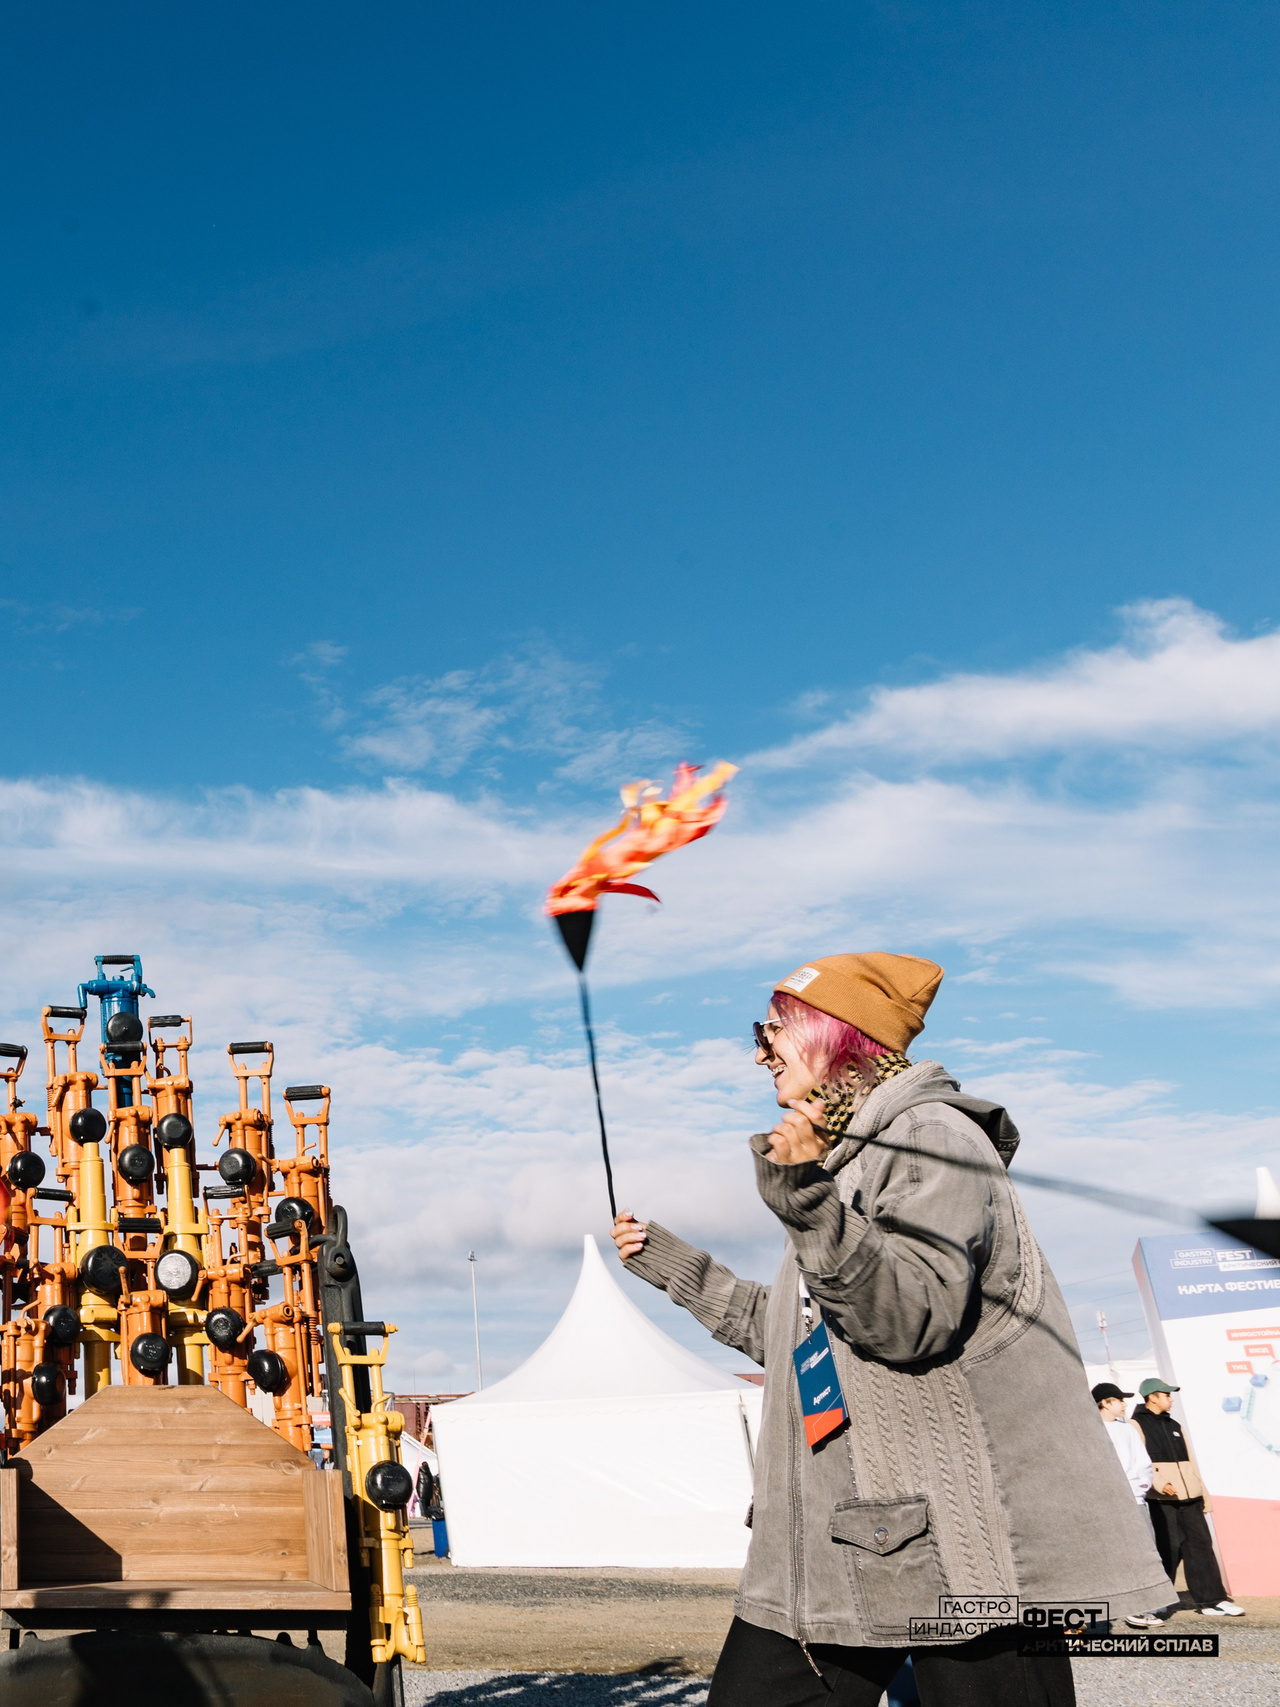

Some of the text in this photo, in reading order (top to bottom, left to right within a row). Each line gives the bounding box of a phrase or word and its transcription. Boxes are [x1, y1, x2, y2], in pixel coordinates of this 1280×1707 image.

[1178, 1250, 1212, 1259] GASTRO
[1216, 1249, 1252, 1261] FEST
[1173, 1258, 1213, 1267] INDUSTRY
[1177, 1283, 1225, 1295] КАРТА
